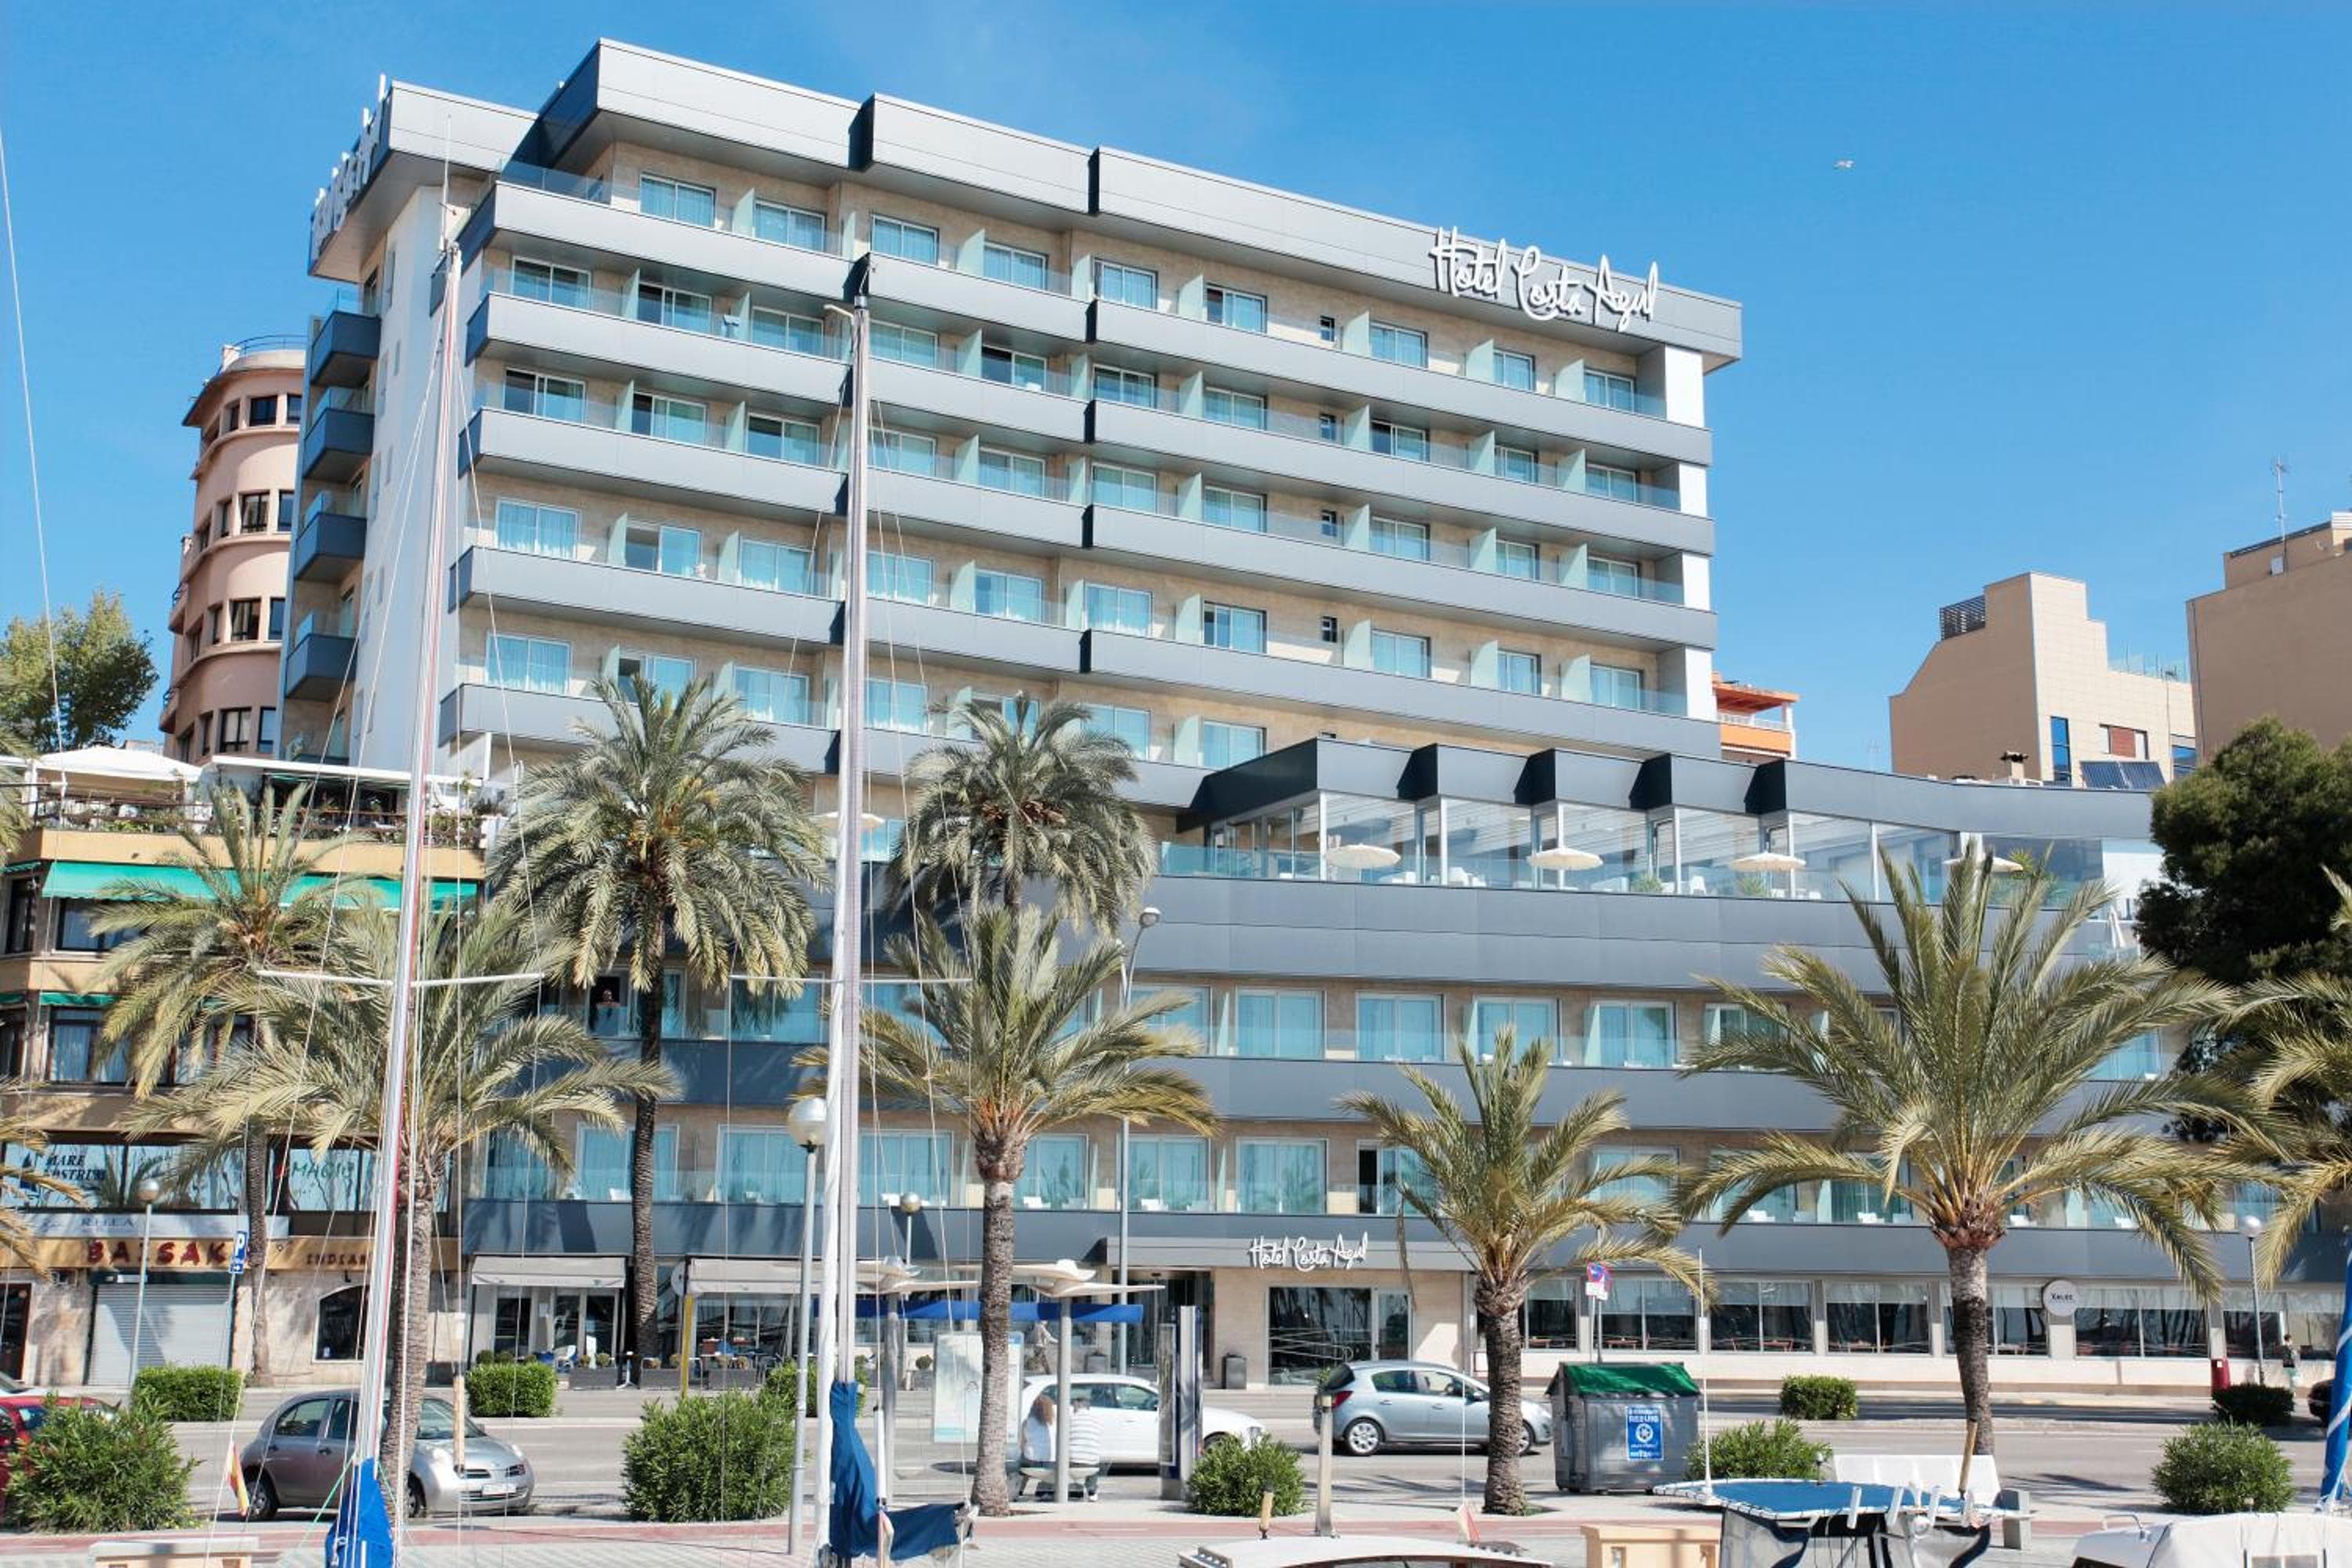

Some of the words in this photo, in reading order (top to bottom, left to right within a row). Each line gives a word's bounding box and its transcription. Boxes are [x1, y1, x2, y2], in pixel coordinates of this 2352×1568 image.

[1428, 225, 1506, 297] Hotel
[1512, 245, 1585, 321] Costa
[1584, 253, 1659, 332] Azul
[1249, 1235, 1290, 1269] Hotel
[1292, 1236, 1330, 1272] Costa
[1330, 1231, 1368, 1270] Azul
